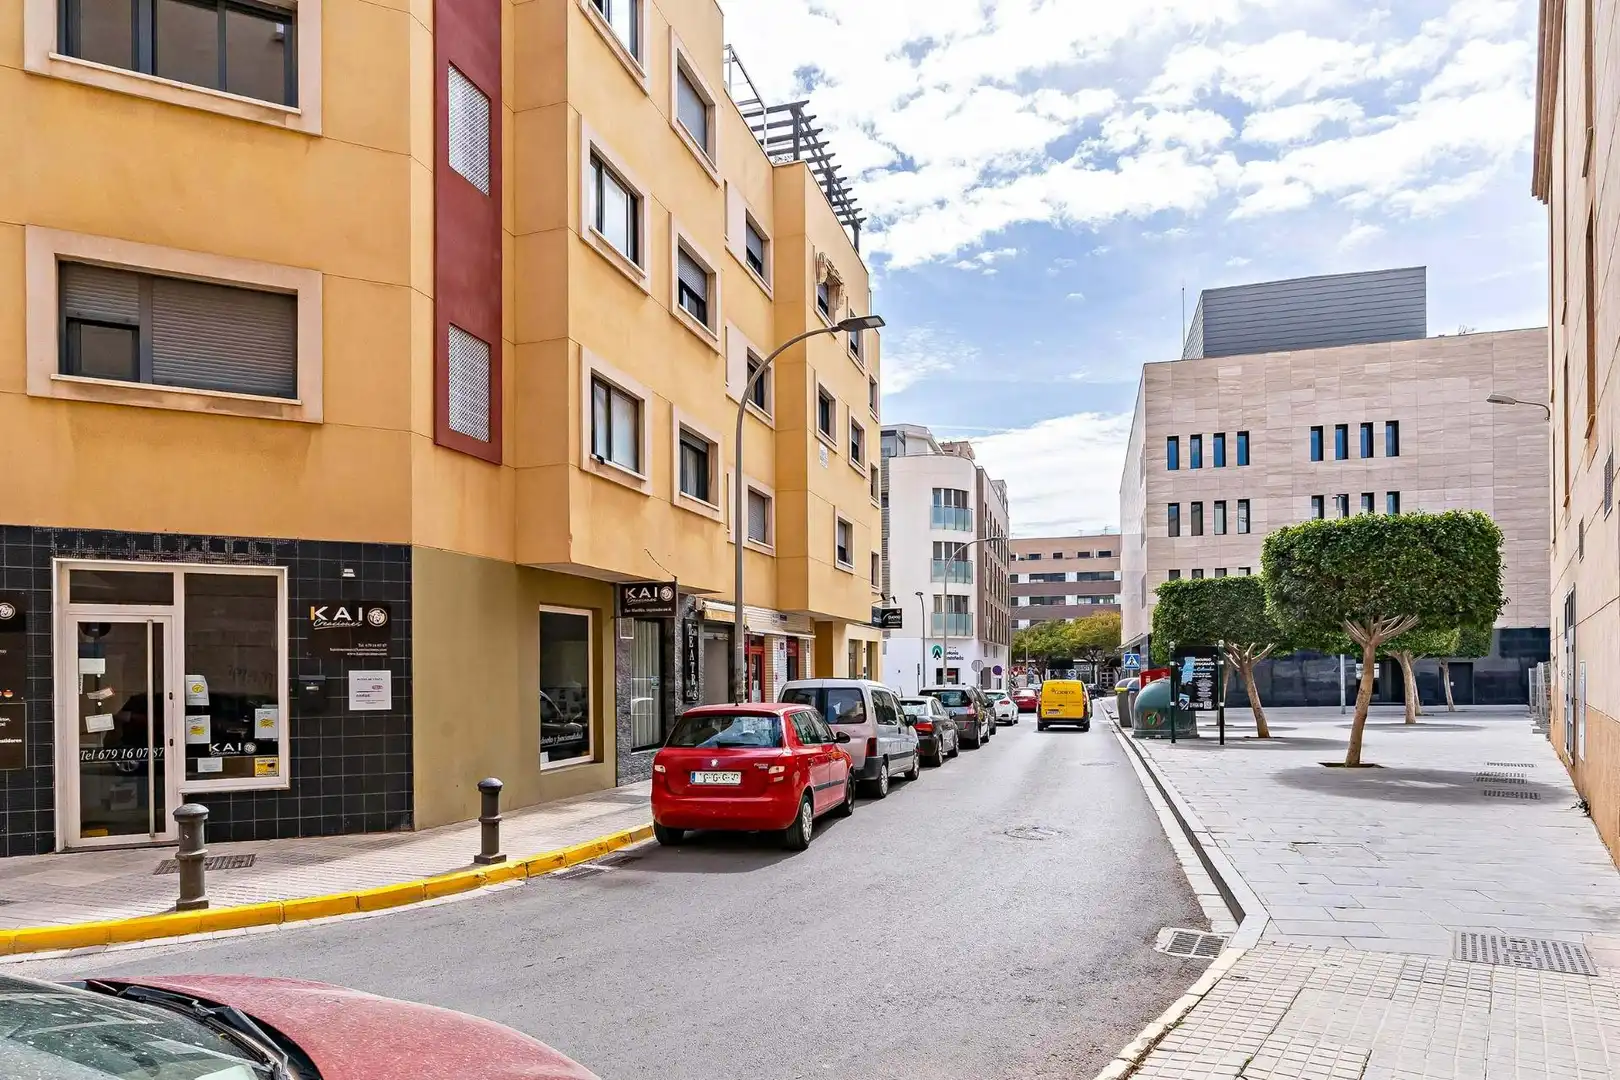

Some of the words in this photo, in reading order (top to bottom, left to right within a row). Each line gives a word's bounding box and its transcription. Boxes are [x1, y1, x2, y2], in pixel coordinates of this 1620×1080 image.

[625, 586, 658, 599] KAI
[310, 606, 363, 621] KAI
[80, 749, 96, 761] Tel
[98, 748, 118, 760] 679
[121, 747, 134, 759] 16
[136, 747, 149, 758] 07
[152, 747, 165, 758] 87
[209, 742, 242, 753] KAI
